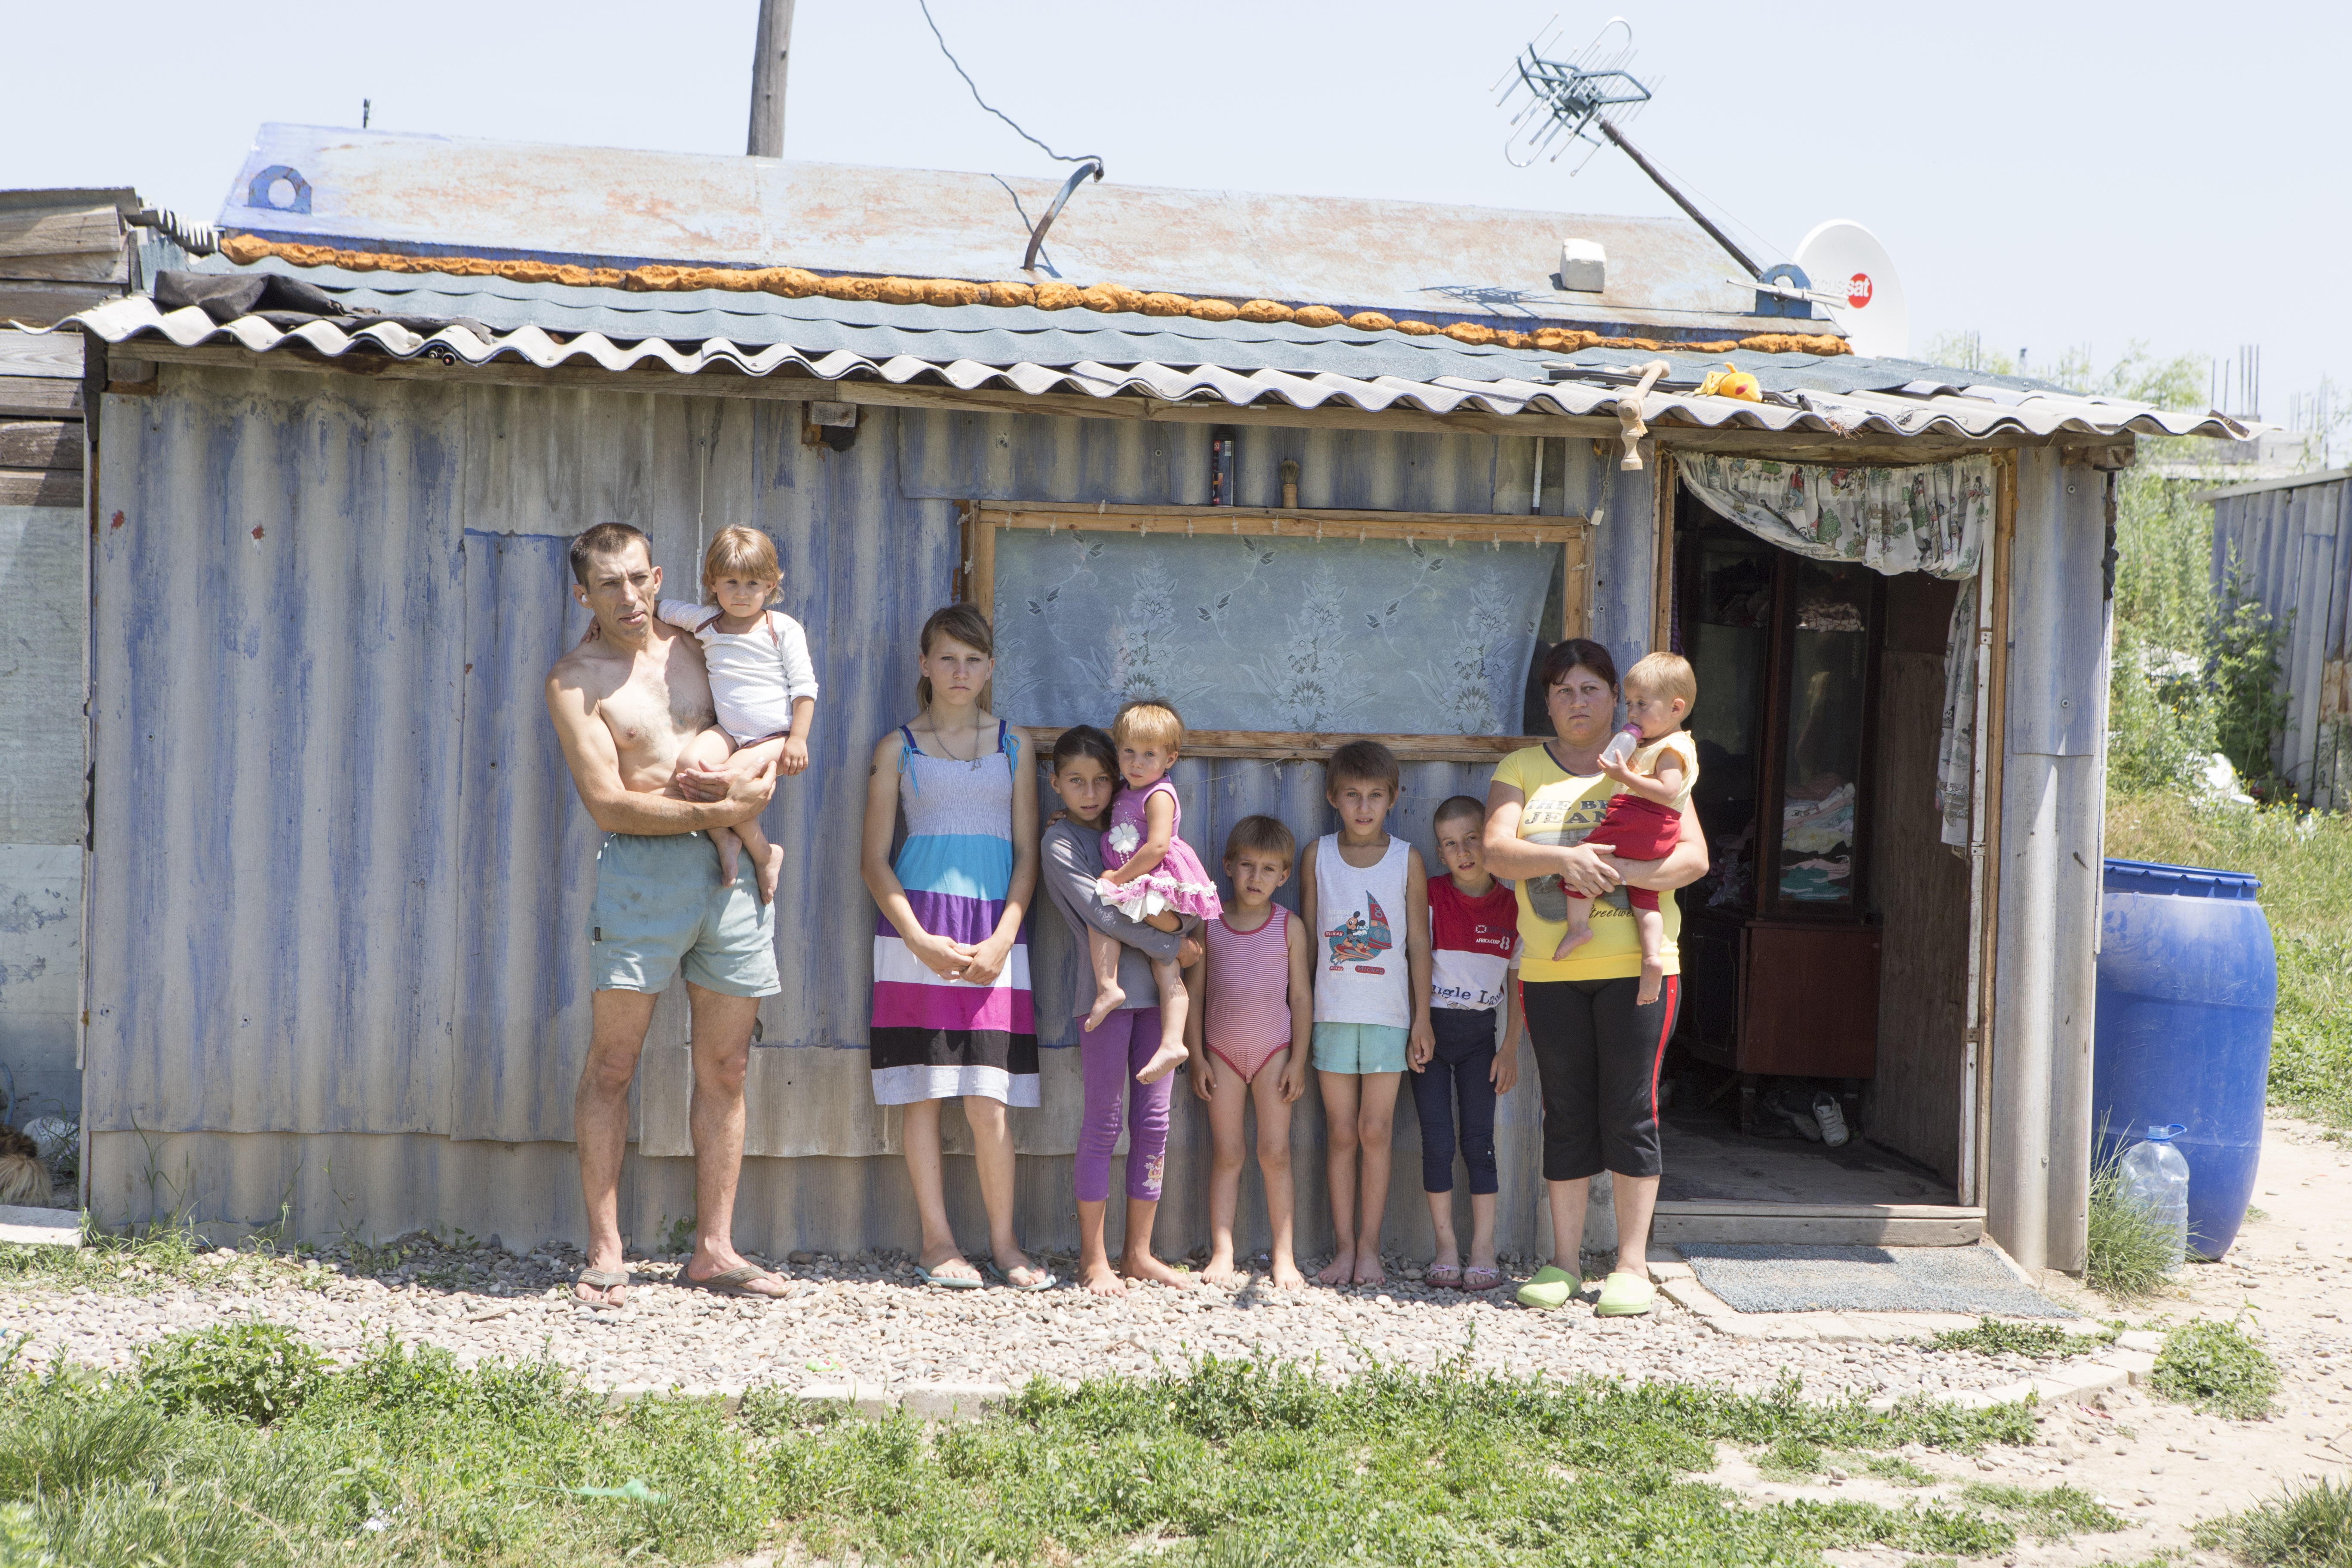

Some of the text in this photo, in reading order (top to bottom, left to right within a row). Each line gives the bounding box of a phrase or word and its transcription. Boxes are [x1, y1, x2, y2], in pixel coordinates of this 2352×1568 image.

[1847, 278, 1869, 297] sat
[1526, 799, 1609, 810] THE BE
[1525, 811, 1606, 824] JEAN
[1375, 907, 1383, 918] 8
[1357, 966, 1384, 974] Mickey
[1432, 985, 1471, 1000] ngle
